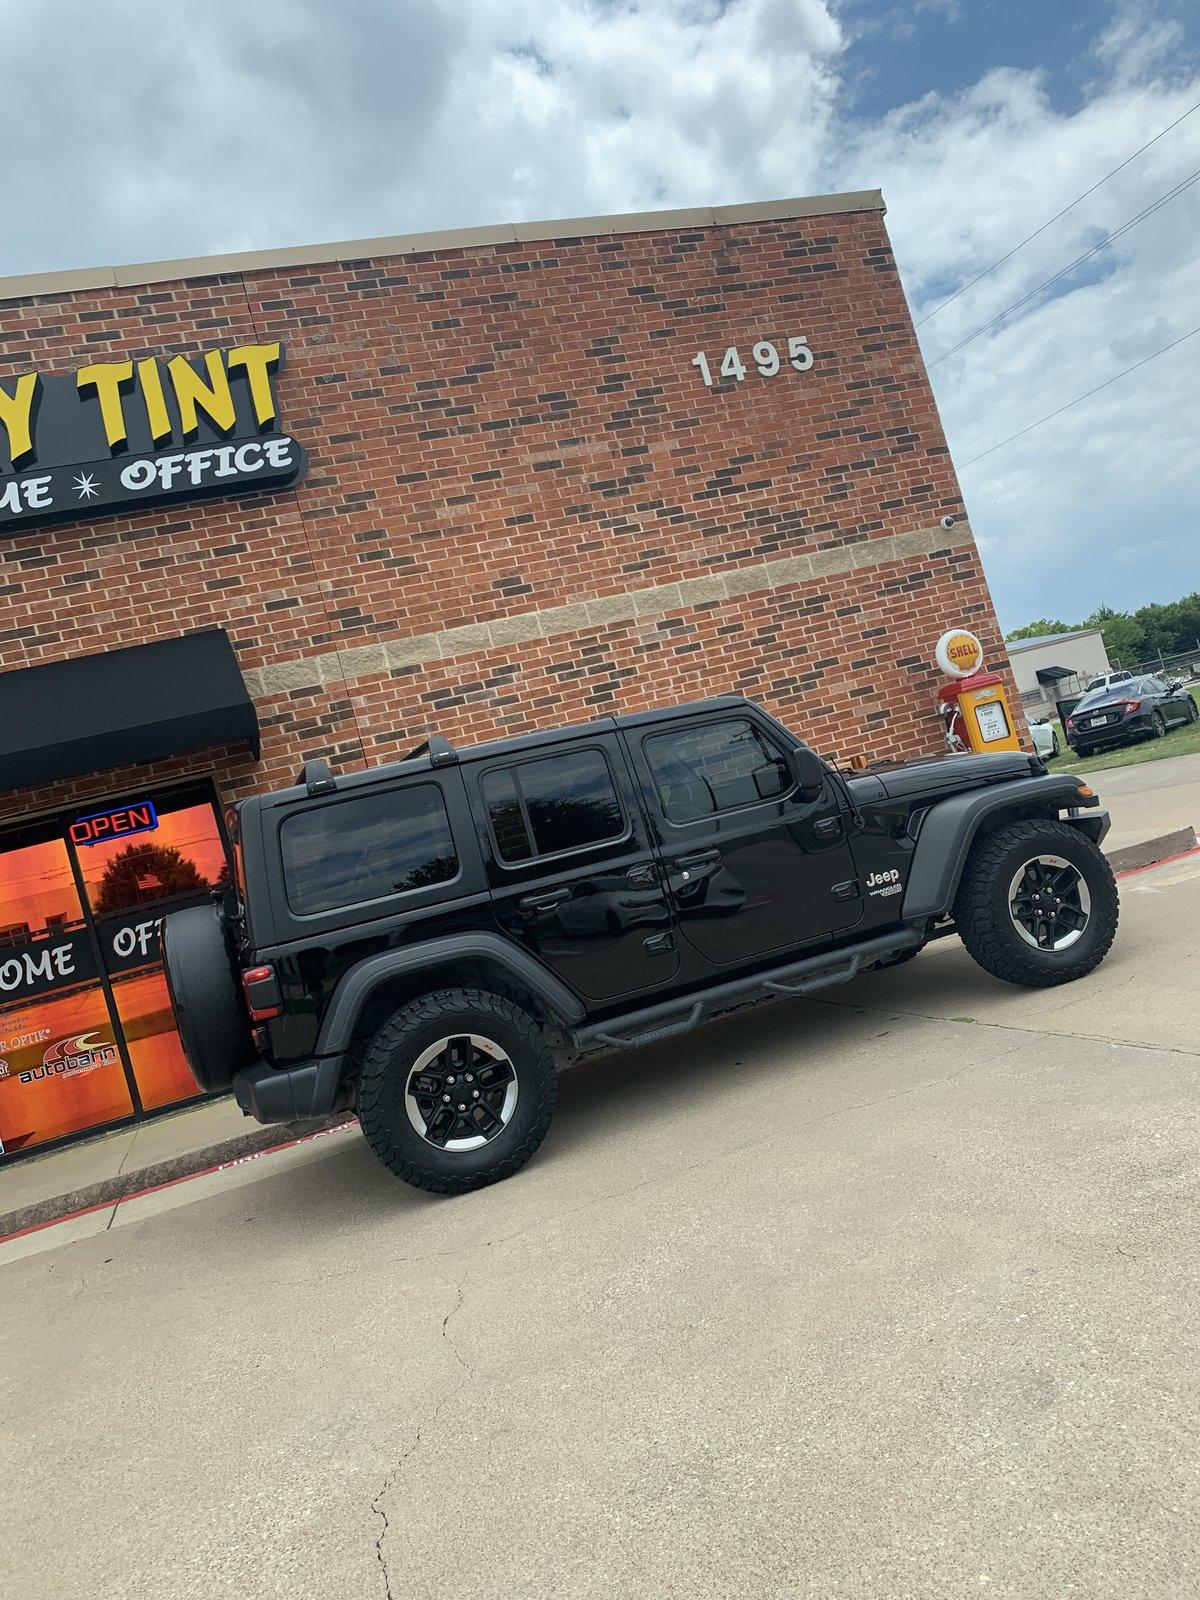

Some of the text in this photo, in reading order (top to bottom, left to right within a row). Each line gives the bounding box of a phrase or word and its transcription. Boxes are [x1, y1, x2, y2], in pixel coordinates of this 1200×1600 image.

[692, 336, 814, 386] 1495
[77, 341, 281, 448] TINT
[120, 438, 293, 490] OFFICE
[949, 644, 978, 659] SHELL
[69, 807, 150, 842] OPEN
[866, 869, 900, 887] Jeep
[18, 1046, 117, 1085] autobahn
